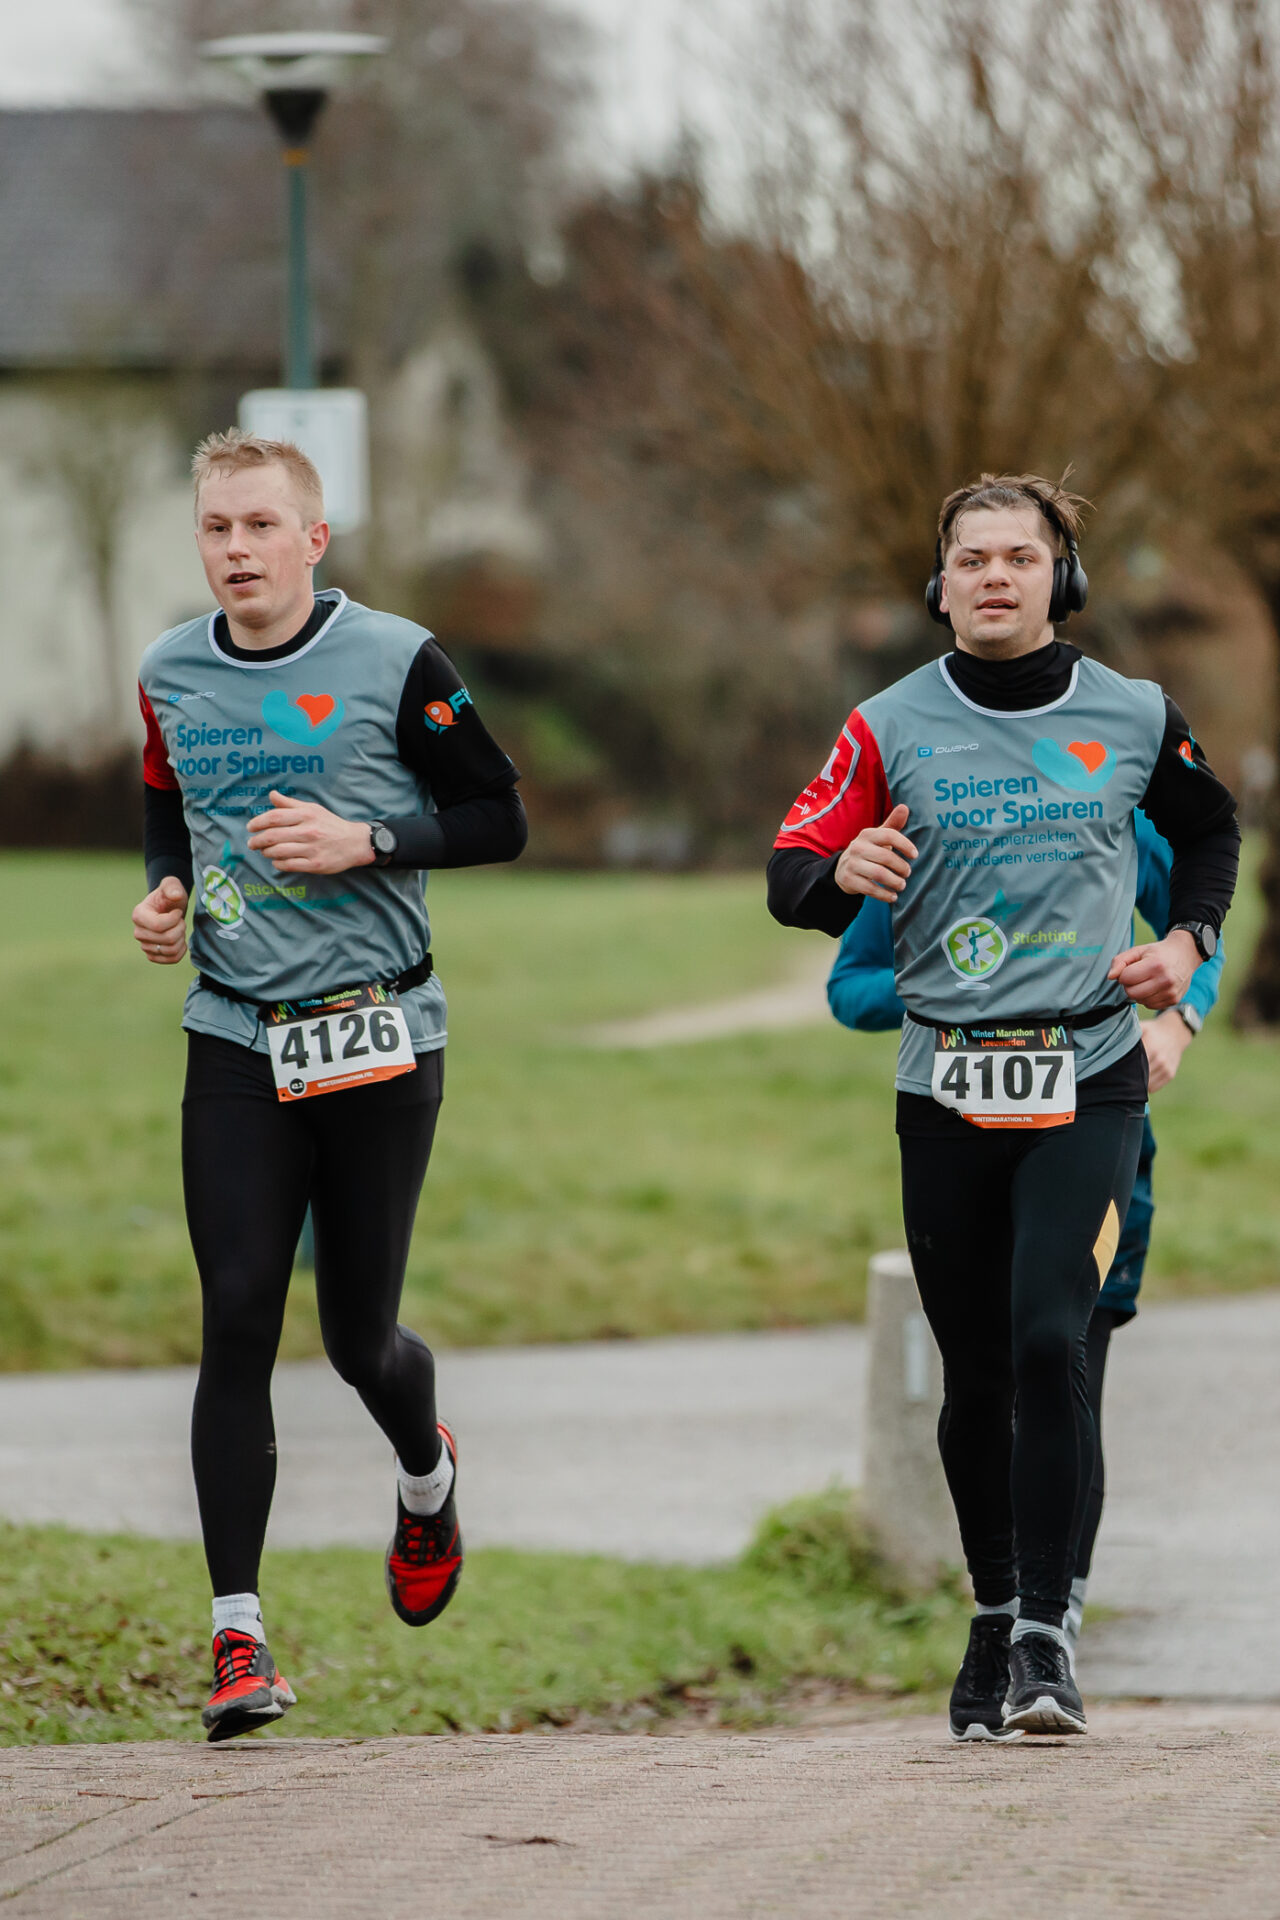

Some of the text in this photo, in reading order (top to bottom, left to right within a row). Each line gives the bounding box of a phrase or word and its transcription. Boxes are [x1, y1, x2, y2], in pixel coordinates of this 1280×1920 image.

[176, 722, 262, 753] Spieren
[177, 750, 324, 780] voor Spieren
[934, 775, 1038, 805] Spieren
[937, 798, 1103, 829] voor Spieren
[941, 830, 1077, 853] Samen spierziekten
[945, 849, 1085, 870] bij kinderen verslaan
[1012, 930, 1077, 945] Stichting
[280, 1010, 400, 1070] 4126
[971, 1029, 1034, 1038] Winter Marathon
[940, 1055, 1064, 1100] 4107
